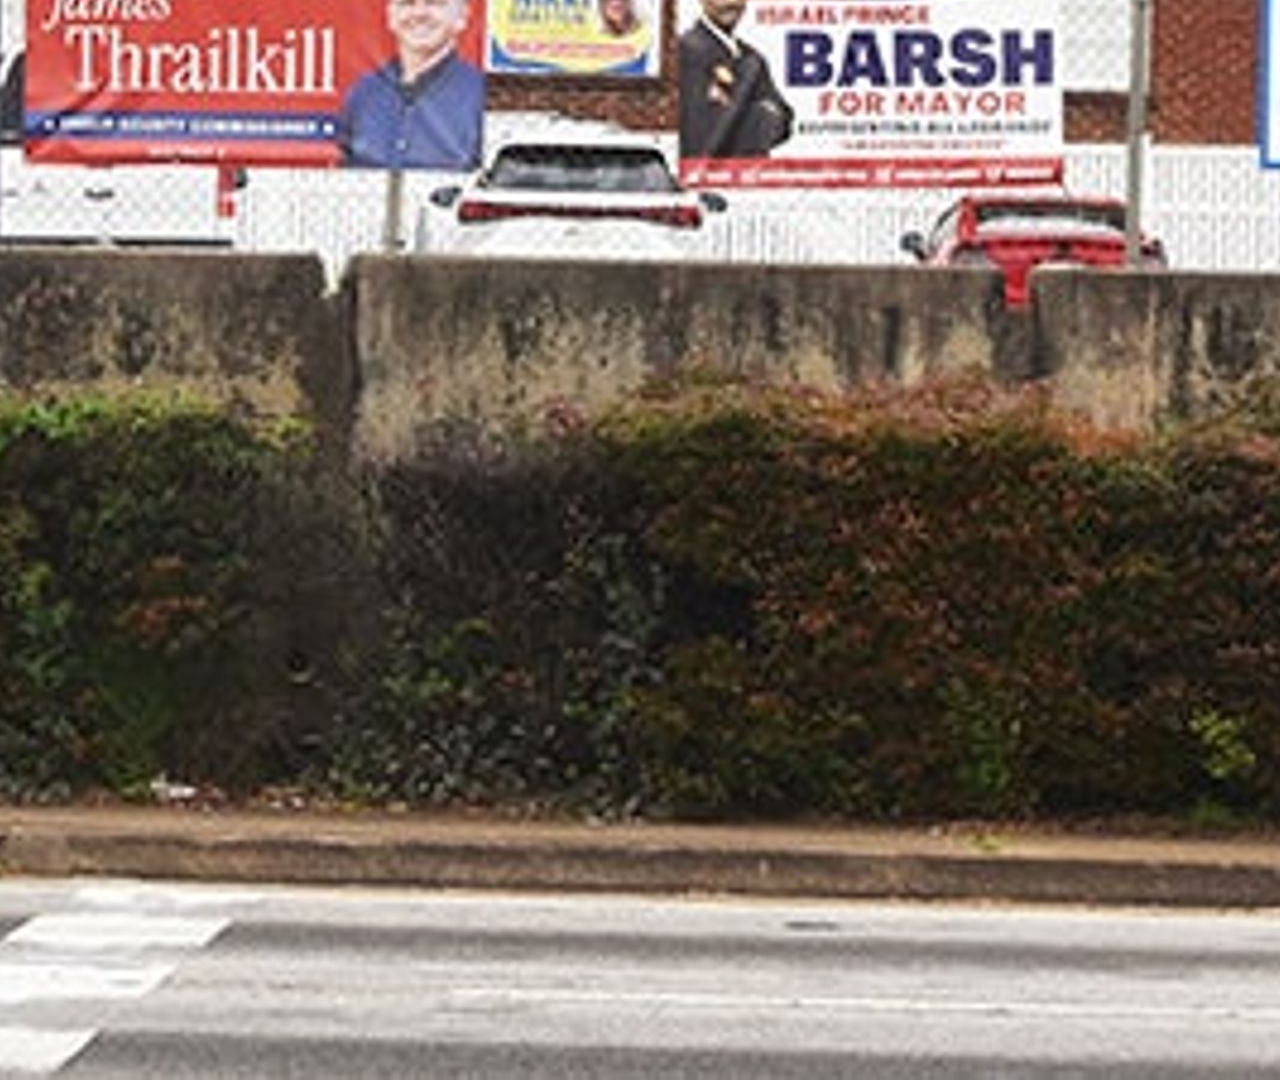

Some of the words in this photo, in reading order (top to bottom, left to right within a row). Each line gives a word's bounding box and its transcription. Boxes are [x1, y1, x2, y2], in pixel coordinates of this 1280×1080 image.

[843, 6, 930, 27] PRINCE
[63, 24, 336, 94] Thrailkill
[785, 29, 1055, 88] BARSH
[817, 92, 886, 116] FOR
[895, 91, 1027, 116] MAYOR
